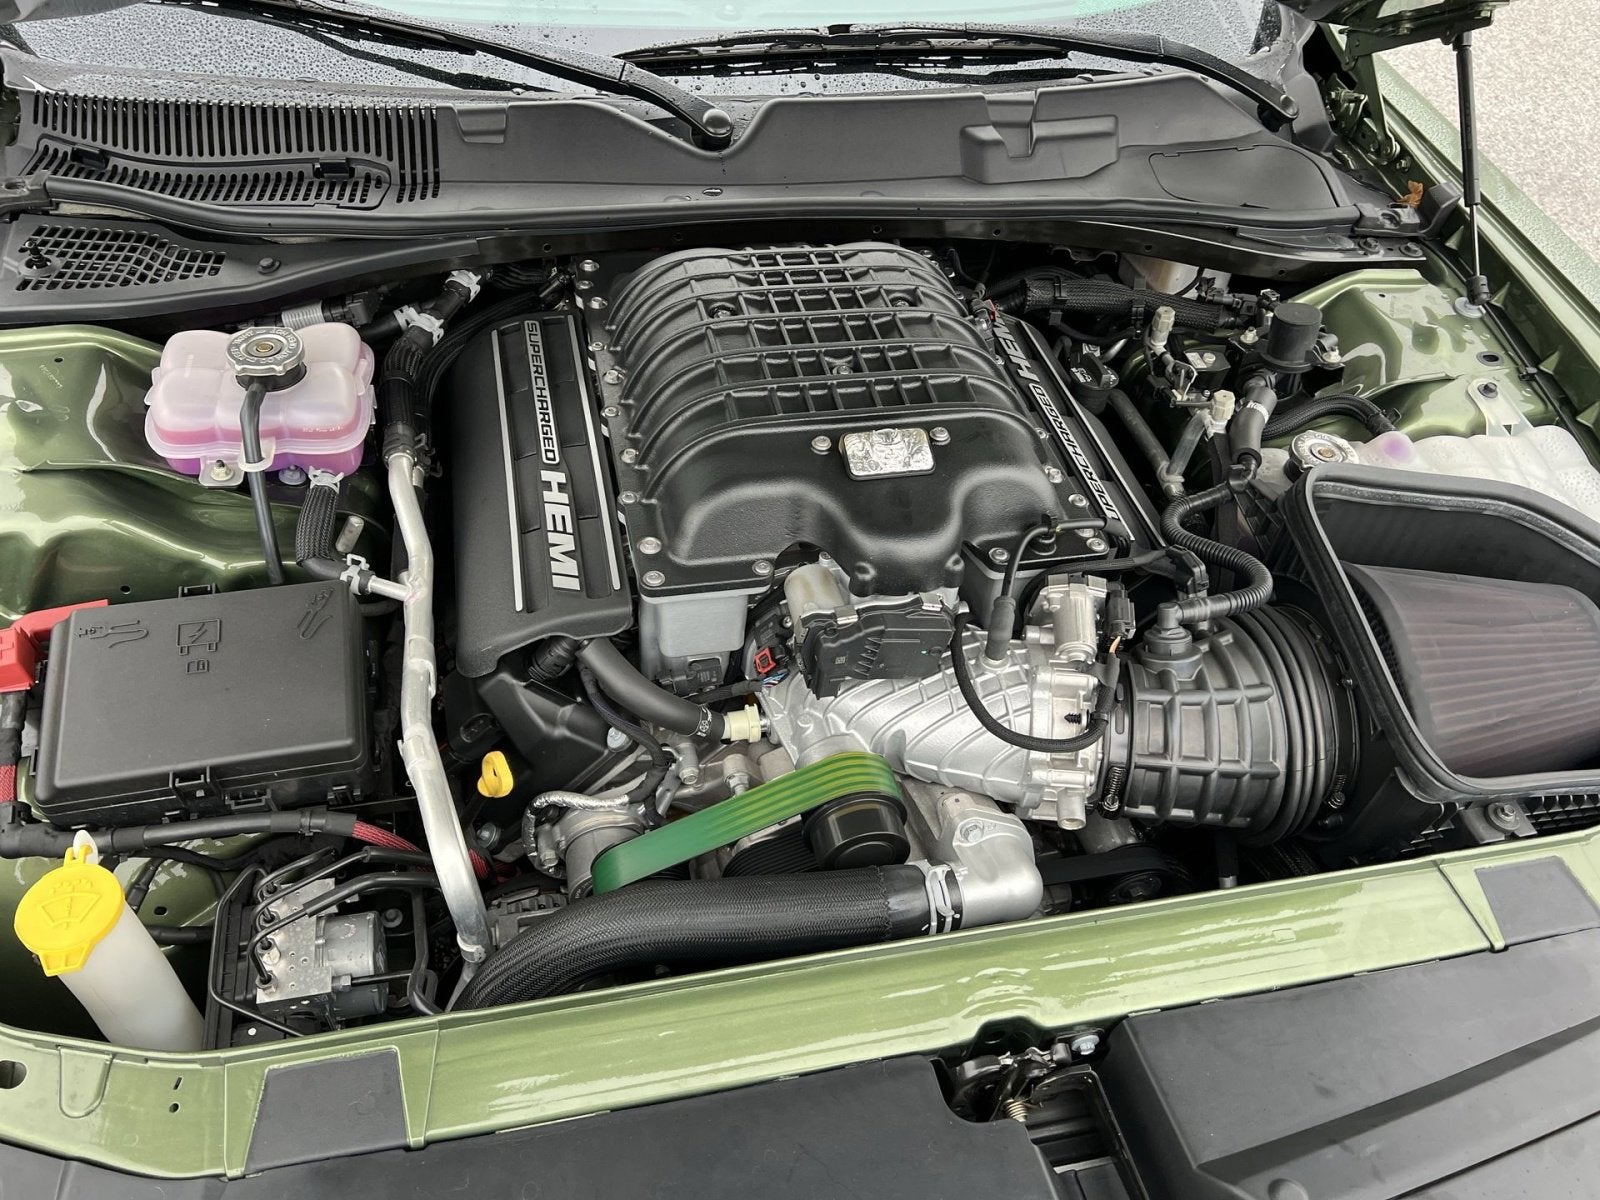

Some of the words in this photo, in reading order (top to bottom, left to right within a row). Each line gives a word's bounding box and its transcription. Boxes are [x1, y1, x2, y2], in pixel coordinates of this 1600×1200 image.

[526, 321, 557, 463] SUPERCHARGED
[1031, 384, 1121, 522] UPERCHARGED
[540, 469, 581, 591] HEMI
